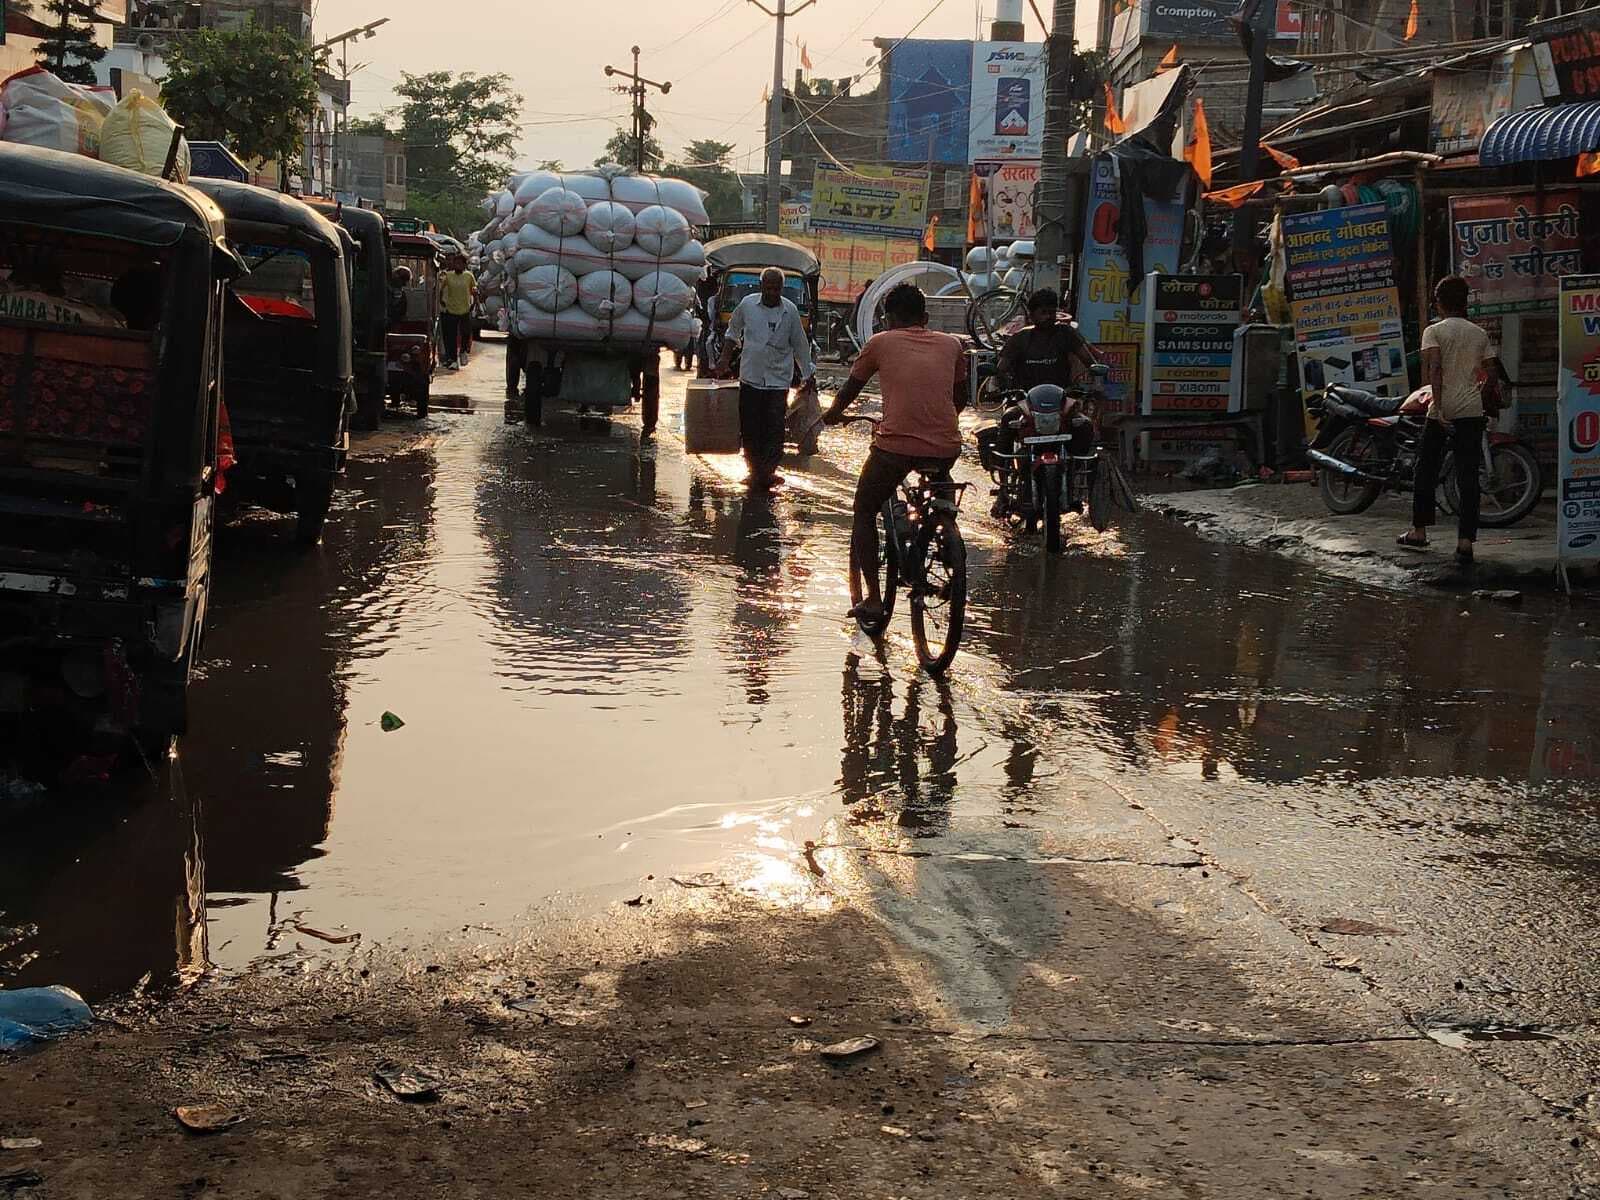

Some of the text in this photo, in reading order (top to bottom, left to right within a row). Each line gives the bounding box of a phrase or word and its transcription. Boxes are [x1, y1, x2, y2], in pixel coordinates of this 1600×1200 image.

[1155, 5, 1217, 19] Crompton
[1287, 219, 1388, 248] आनन्द मोबाइल
[1484, 257, 1504, 281] एंड
[1160, 279, 1200, 294] लोन
[1180, 312, 1228, 321] motorola
[1158, 339, 1232, 351] SAMSUNG
[1167, 367, 1218, 377] realme
[1179, 383, 1221, 393] xiaomi
